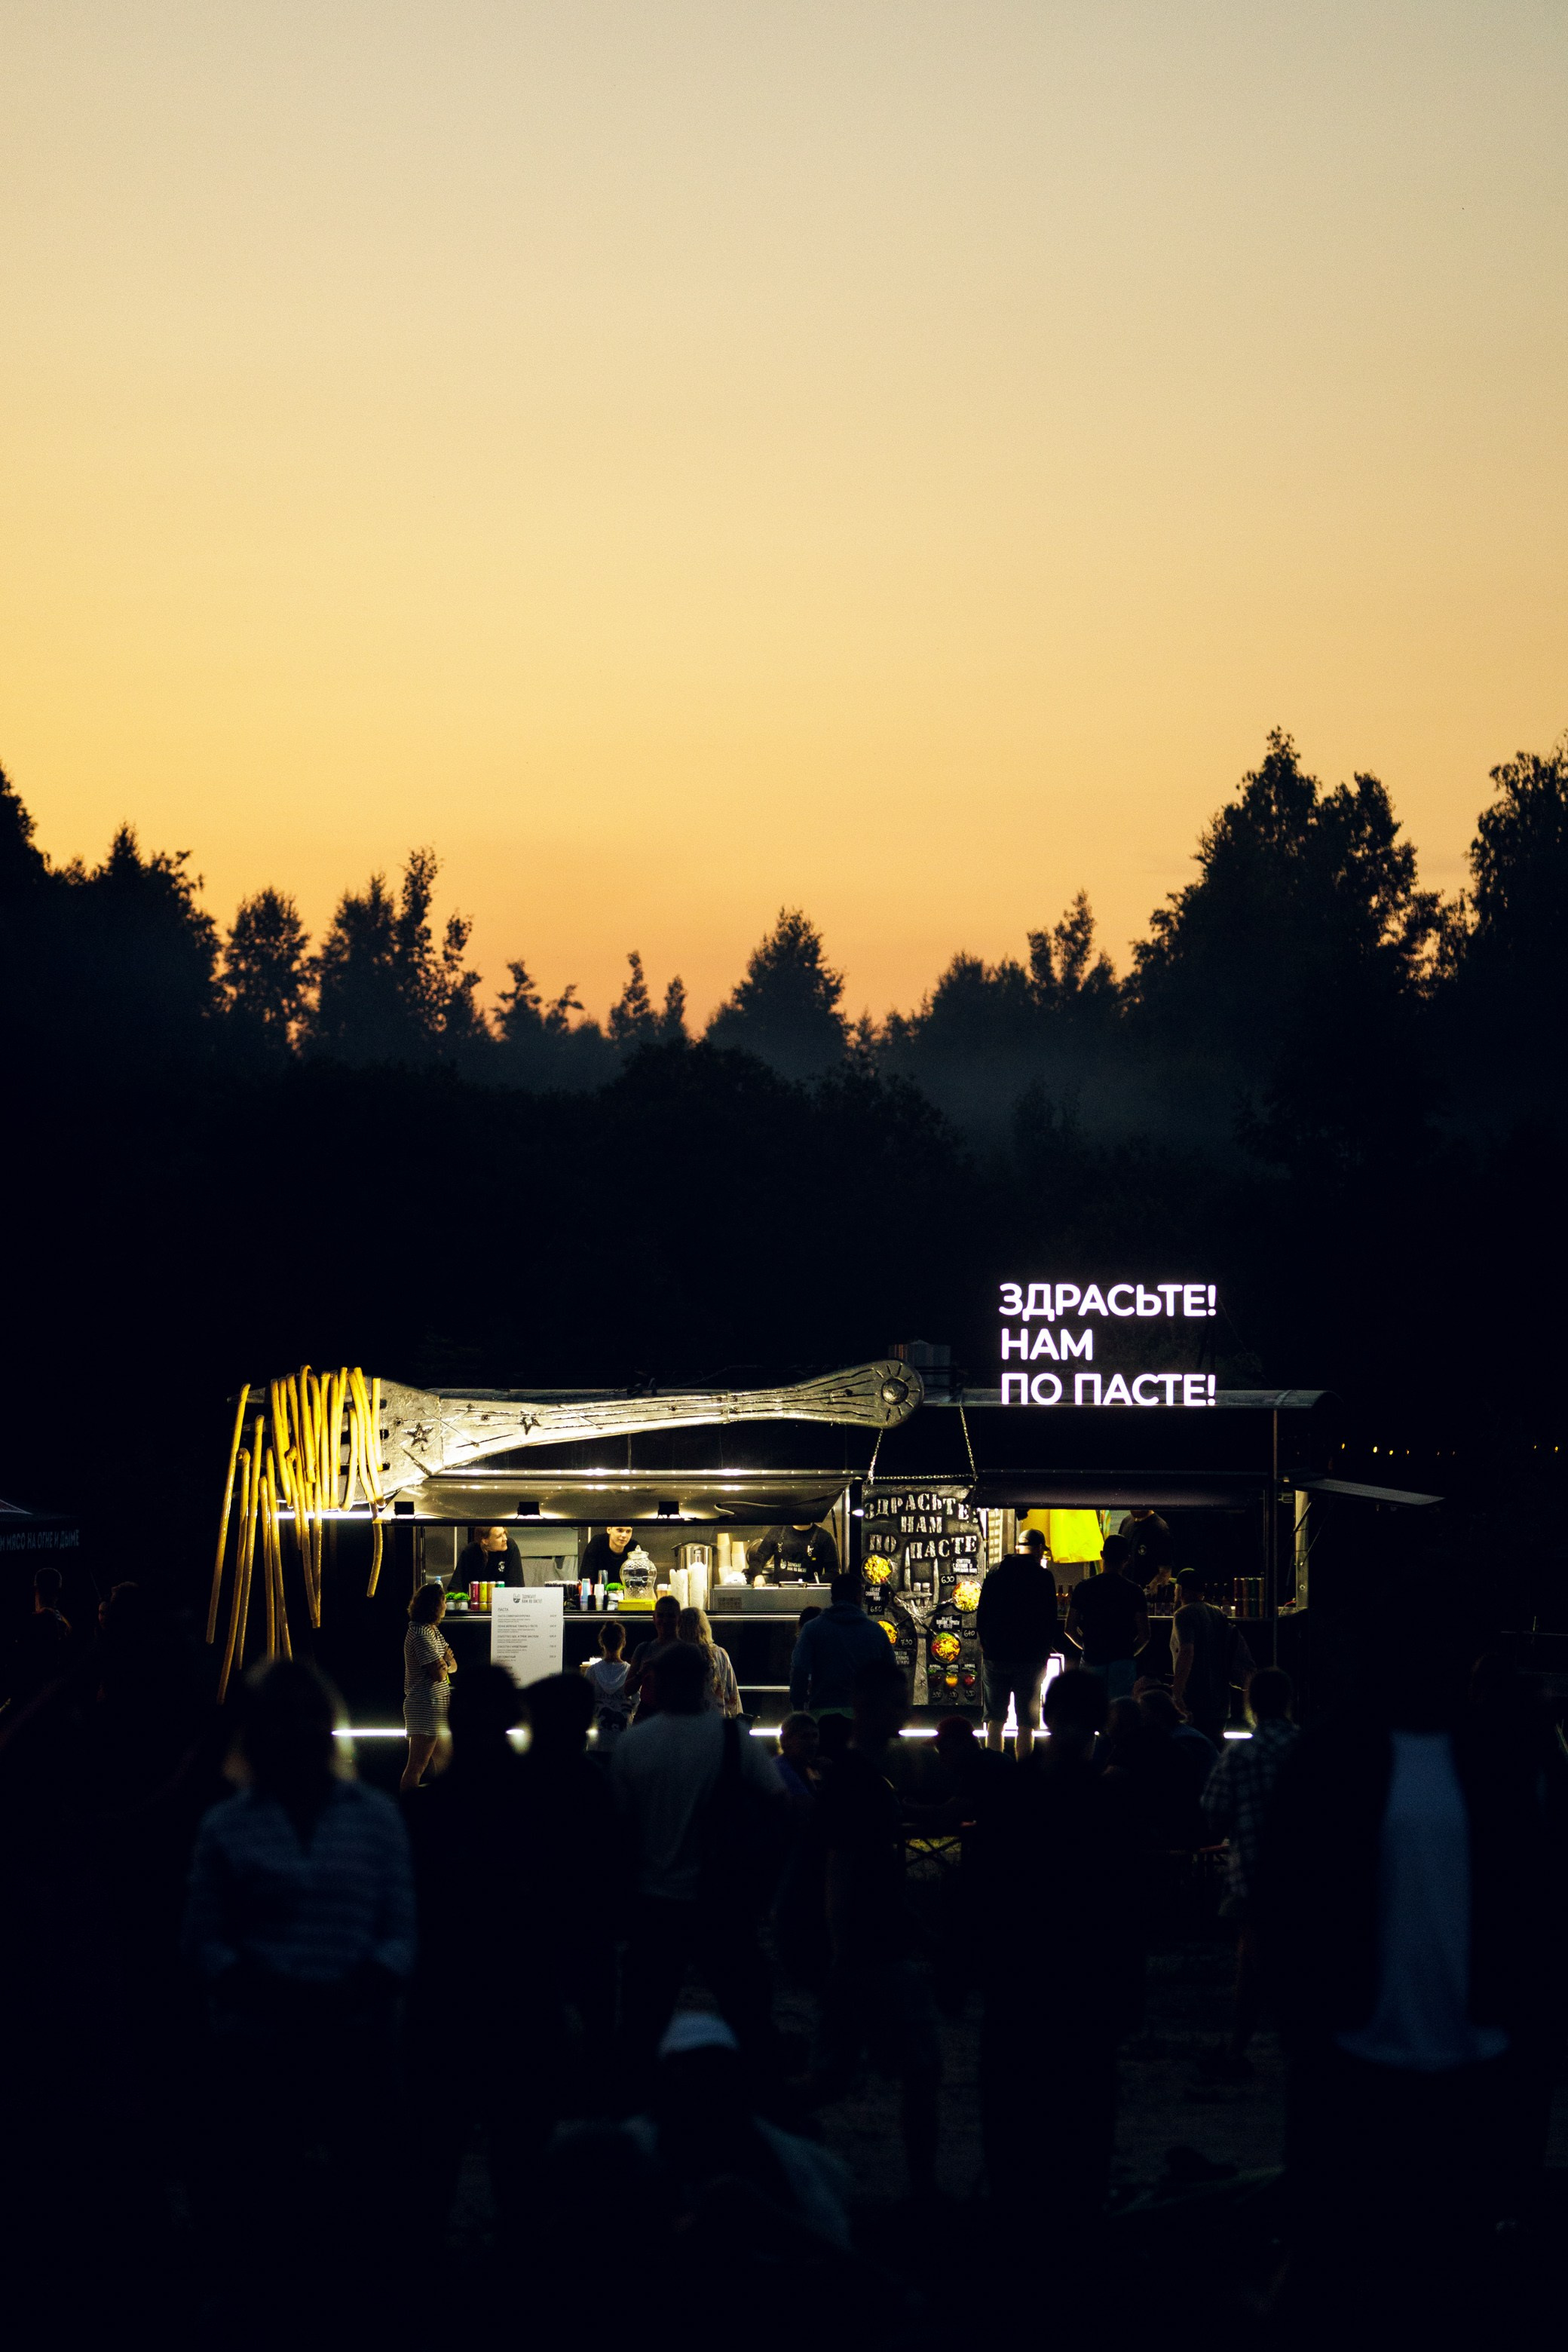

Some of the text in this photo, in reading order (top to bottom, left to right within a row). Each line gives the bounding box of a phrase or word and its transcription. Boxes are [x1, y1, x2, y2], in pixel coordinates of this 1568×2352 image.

[999, 1283, 1217, 1321] ЗДРАСЬТЕ!
[1001, 1328, 1093, 1361] НАМ
[1001, 1373, 1216, 1406] ПО ПАСТЕ!
[901, 1516, 942, 1533] НАМ
[869, 1534, 977, 1559] ПО ПАСТЕ
